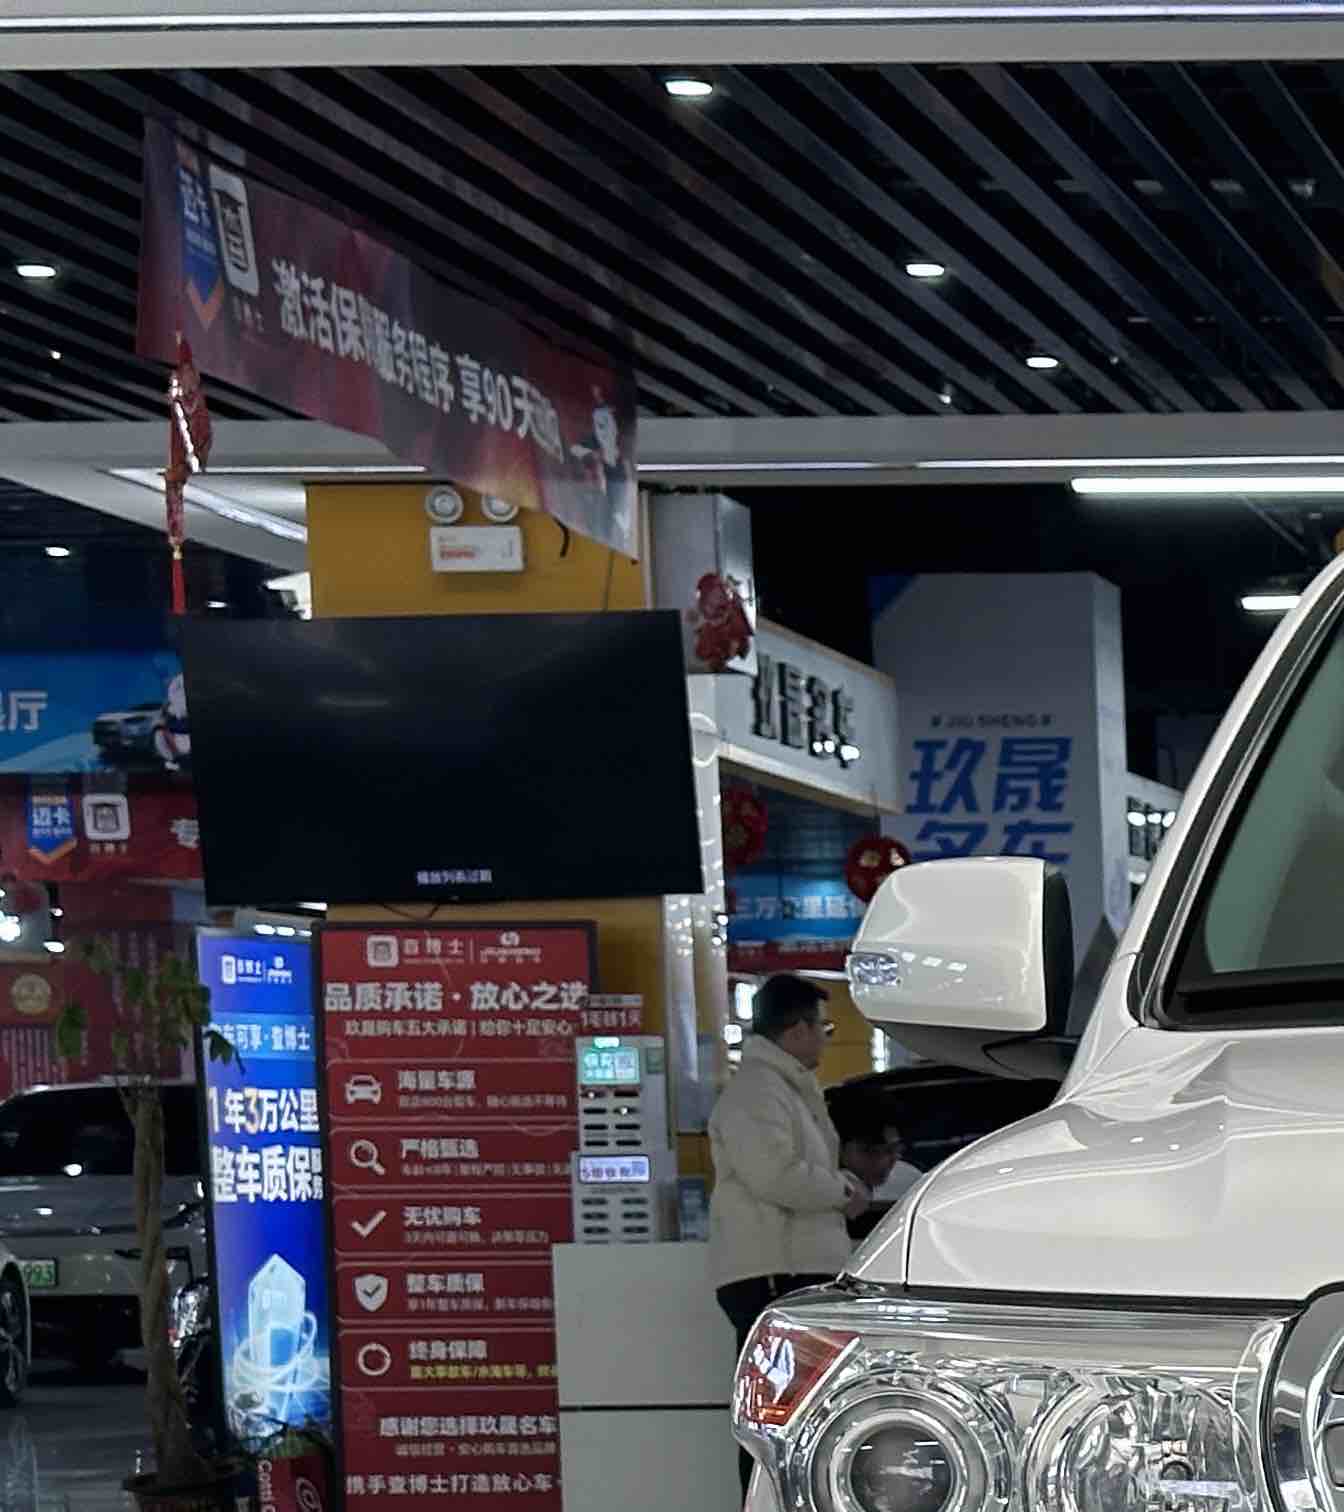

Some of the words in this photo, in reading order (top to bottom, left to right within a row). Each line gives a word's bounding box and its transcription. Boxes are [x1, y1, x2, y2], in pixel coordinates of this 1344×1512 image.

[904, 737, 1073, 815] 玖晟
[208, 1086, 320, 1135] 1年3万公里
[346, 1473, 562, 1496] 携手查博士打造放心车
